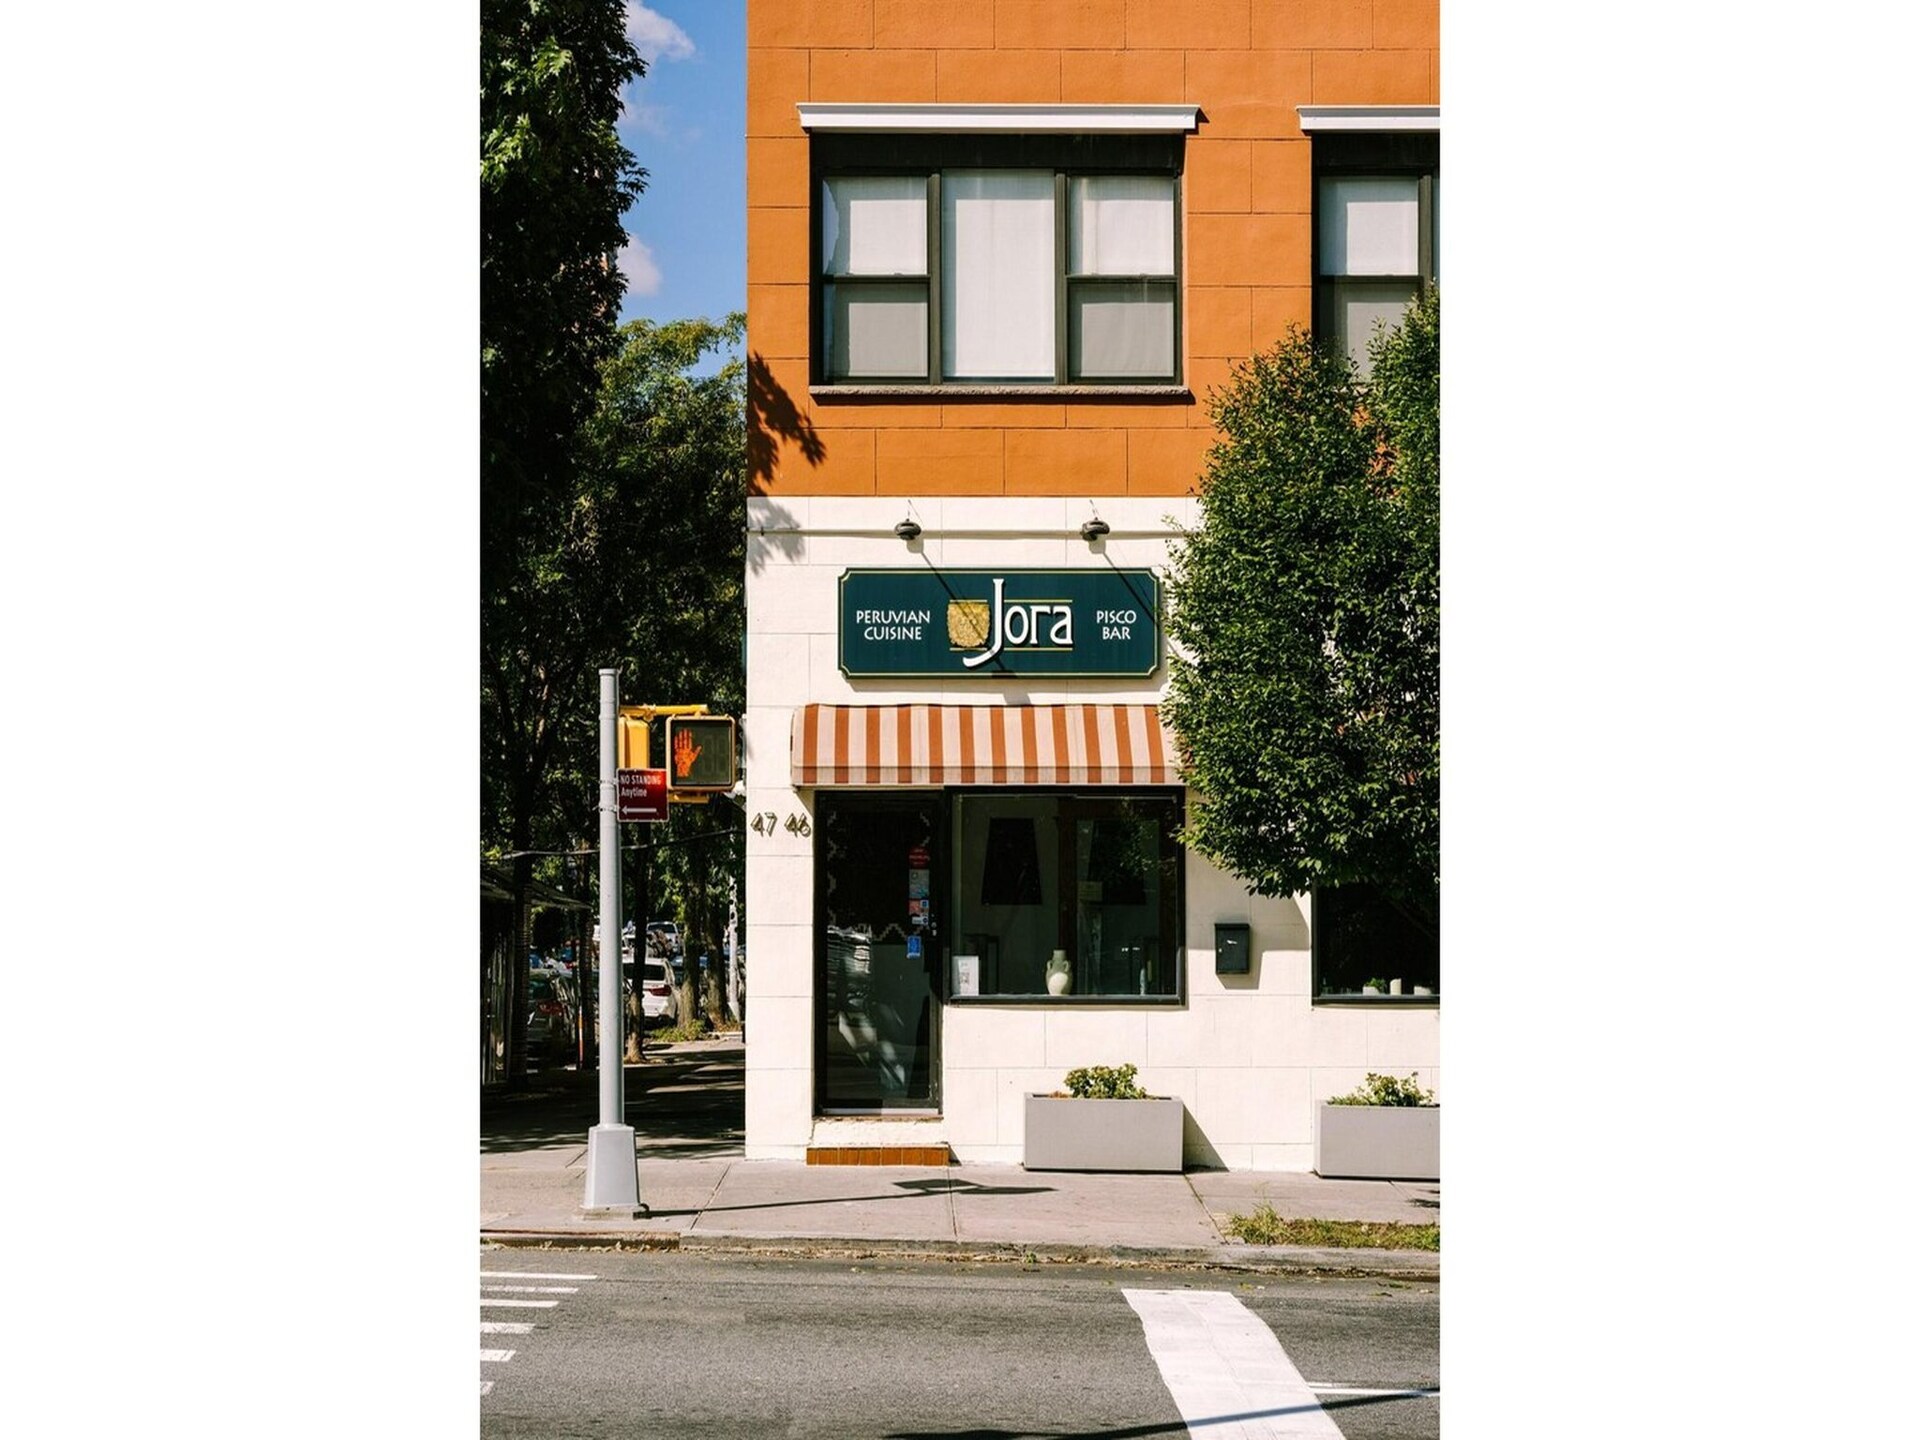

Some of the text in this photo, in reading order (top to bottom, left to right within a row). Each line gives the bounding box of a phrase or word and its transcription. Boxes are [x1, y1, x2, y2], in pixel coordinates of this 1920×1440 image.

[856, 610, 931, 624] PERUVIAN
[963, 578, 1074, 668] Jora
[1096, 610, 1137, 624] PISCO
[864, 626, 922, 640] CUISINE
[1102, 626, 1131, 640] BAR
[620, 775, 662, 785] NO STANDING
[621, 787, 647, 798] Anytime
[750, 812, 811, 838] 47 46
